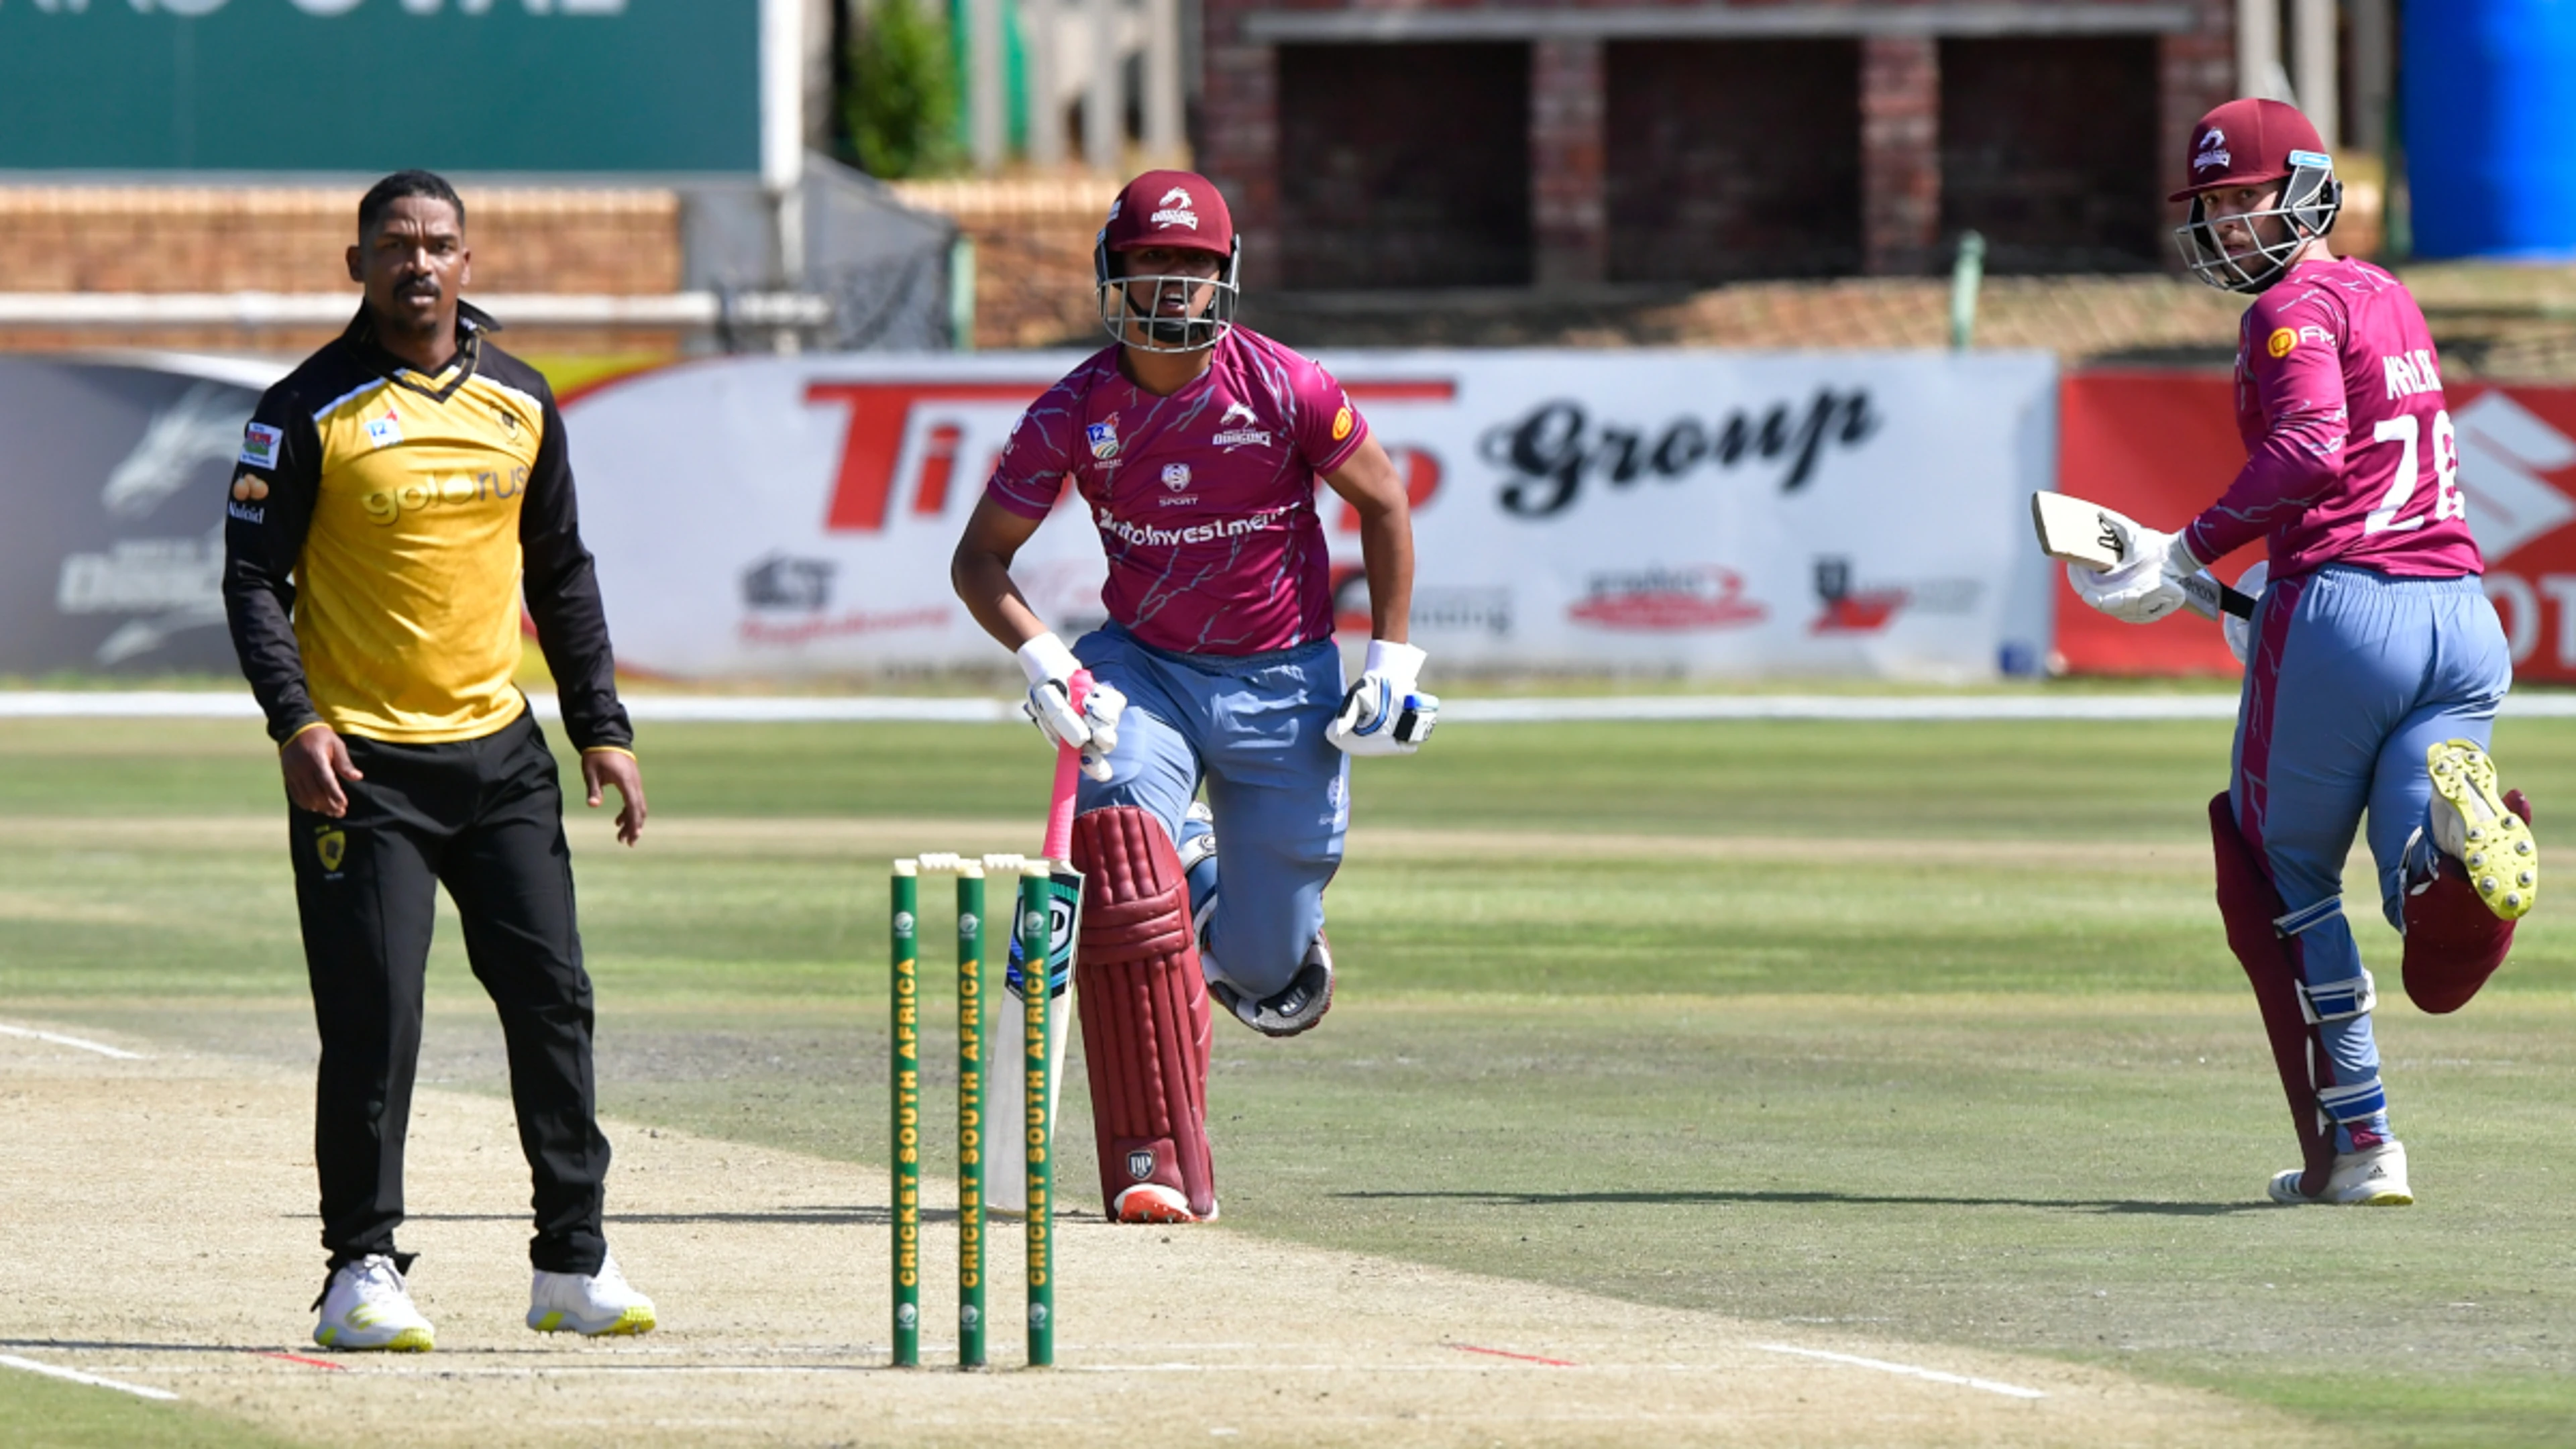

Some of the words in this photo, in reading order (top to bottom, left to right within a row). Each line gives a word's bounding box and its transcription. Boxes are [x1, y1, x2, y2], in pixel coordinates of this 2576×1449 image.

[1476, 388, 1878, 517] Group
[897, 957, 916, 1060] AFRICA
[961, 959, 979, 1061] AFRICA
[1026, 957, 1044, 1060] AFRICA
[900, 1070, 918, 1164] SOUTH
[961, 1071, 979, 1165] SOUTH
[1027, 1070, 1046, 1164] SOUTH
[900, 1172, 917, 1287] CRICKET
[961, 1174, 979, 1289] CRICKET
[1029, 1172, 1047, 1287] CRICKET
